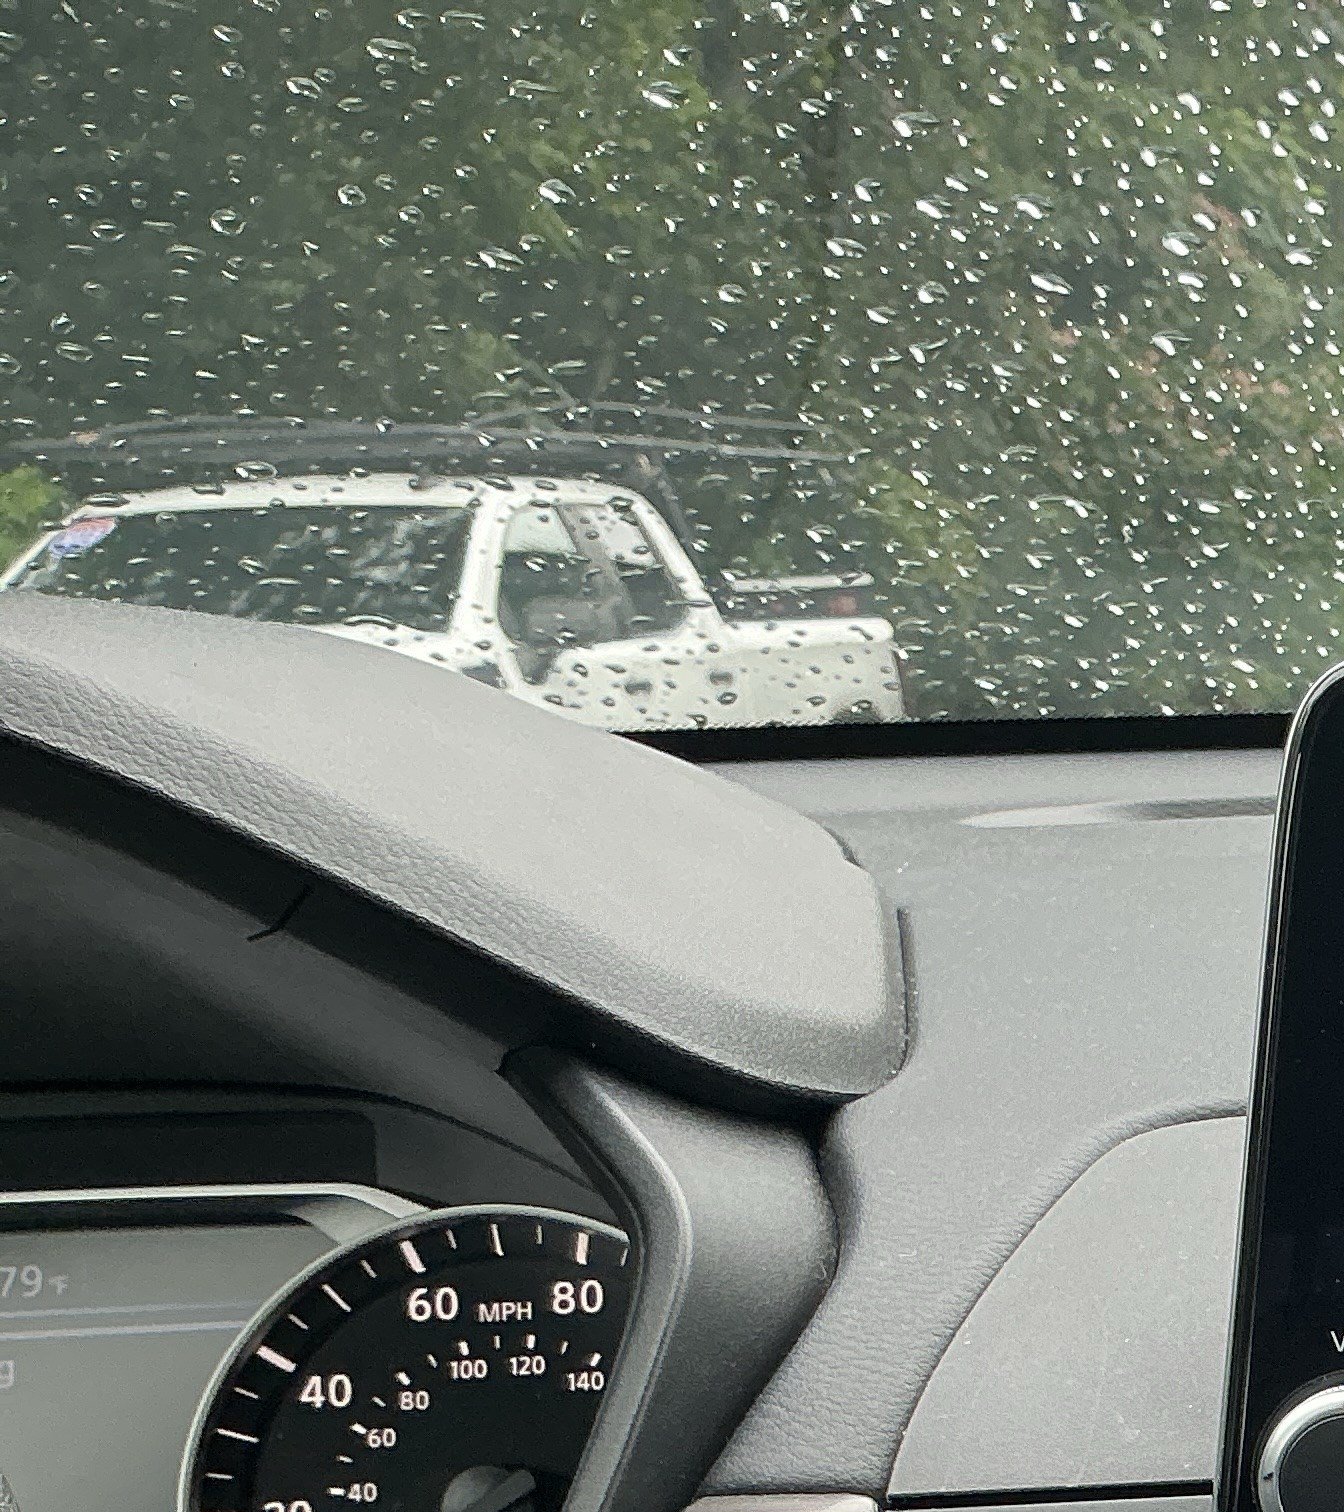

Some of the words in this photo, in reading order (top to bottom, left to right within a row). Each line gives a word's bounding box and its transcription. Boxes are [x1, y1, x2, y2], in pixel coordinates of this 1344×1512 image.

[407, 1286, 459, 1322] 60
[552, 1279, 604, 1314] 80
[478, 1301, 533, 1323] MPH
[450, 1359, 488, 1379] 100
[508, 1355, 545, 1376] 120
[300, 1374, 352, 1407] 40
[567, 1371, 605, 1392] 140
[399, 1391, 430, 1411] 80
[367, 1428, 397, 1449] 60
[347, 1482, 378, 1503] 40
